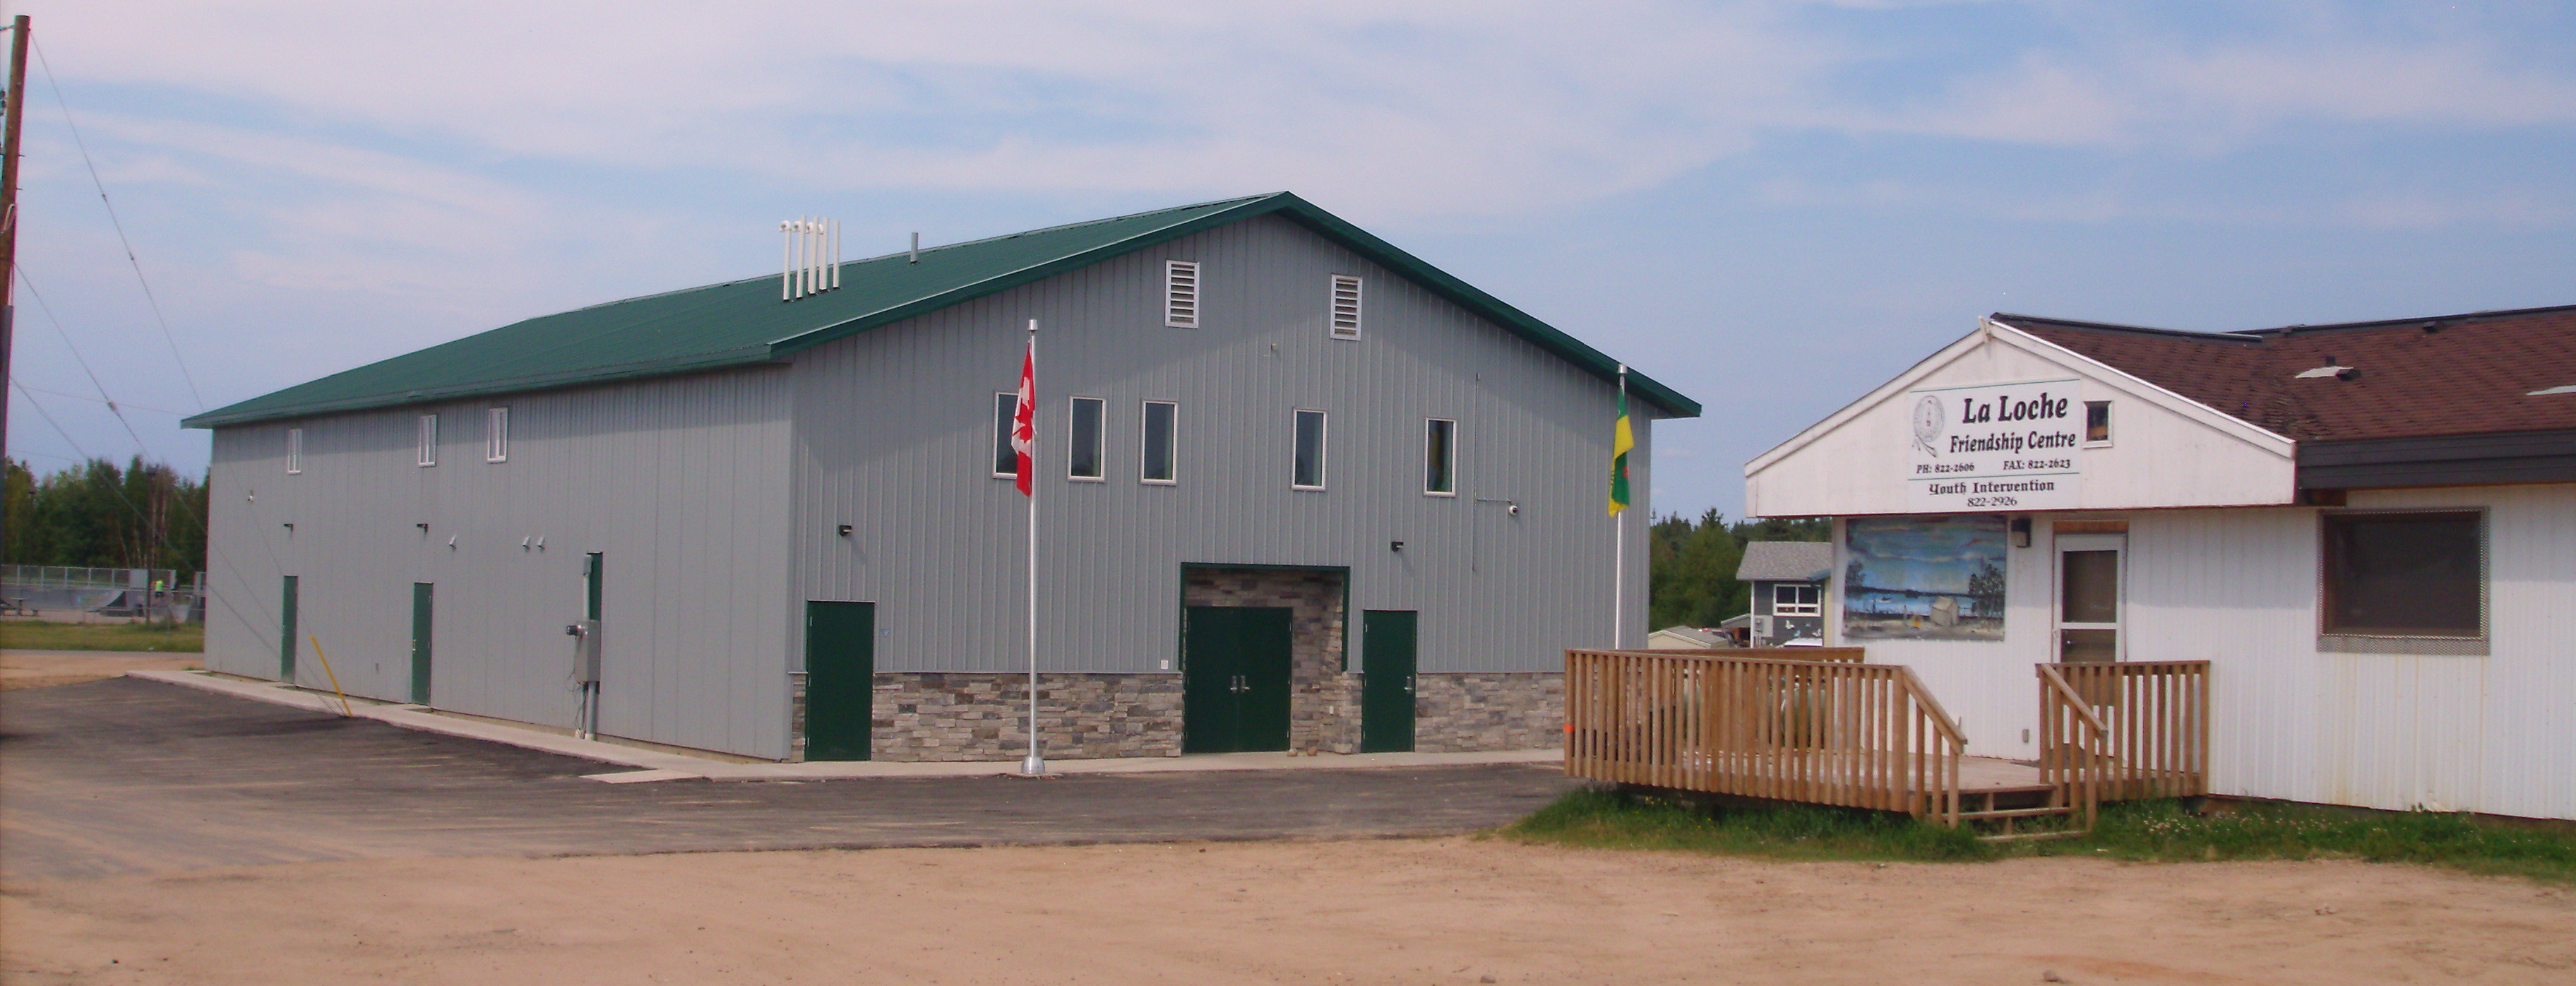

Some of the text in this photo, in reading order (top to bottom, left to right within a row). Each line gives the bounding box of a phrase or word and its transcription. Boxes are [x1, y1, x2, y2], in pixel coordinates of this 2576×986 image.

[1962, 392, 2068, 424] La Loche
[1950, 430, 2076, 453] Friendship Centre
[1916, 463, 1975, 474] PH: 822-2606
[2003, 459, 2071, 470] FAX: 822-2623
[1929, 480, 2055, 495] Youth Intervention
[1967, 497, 2017, 507] 822-2926
